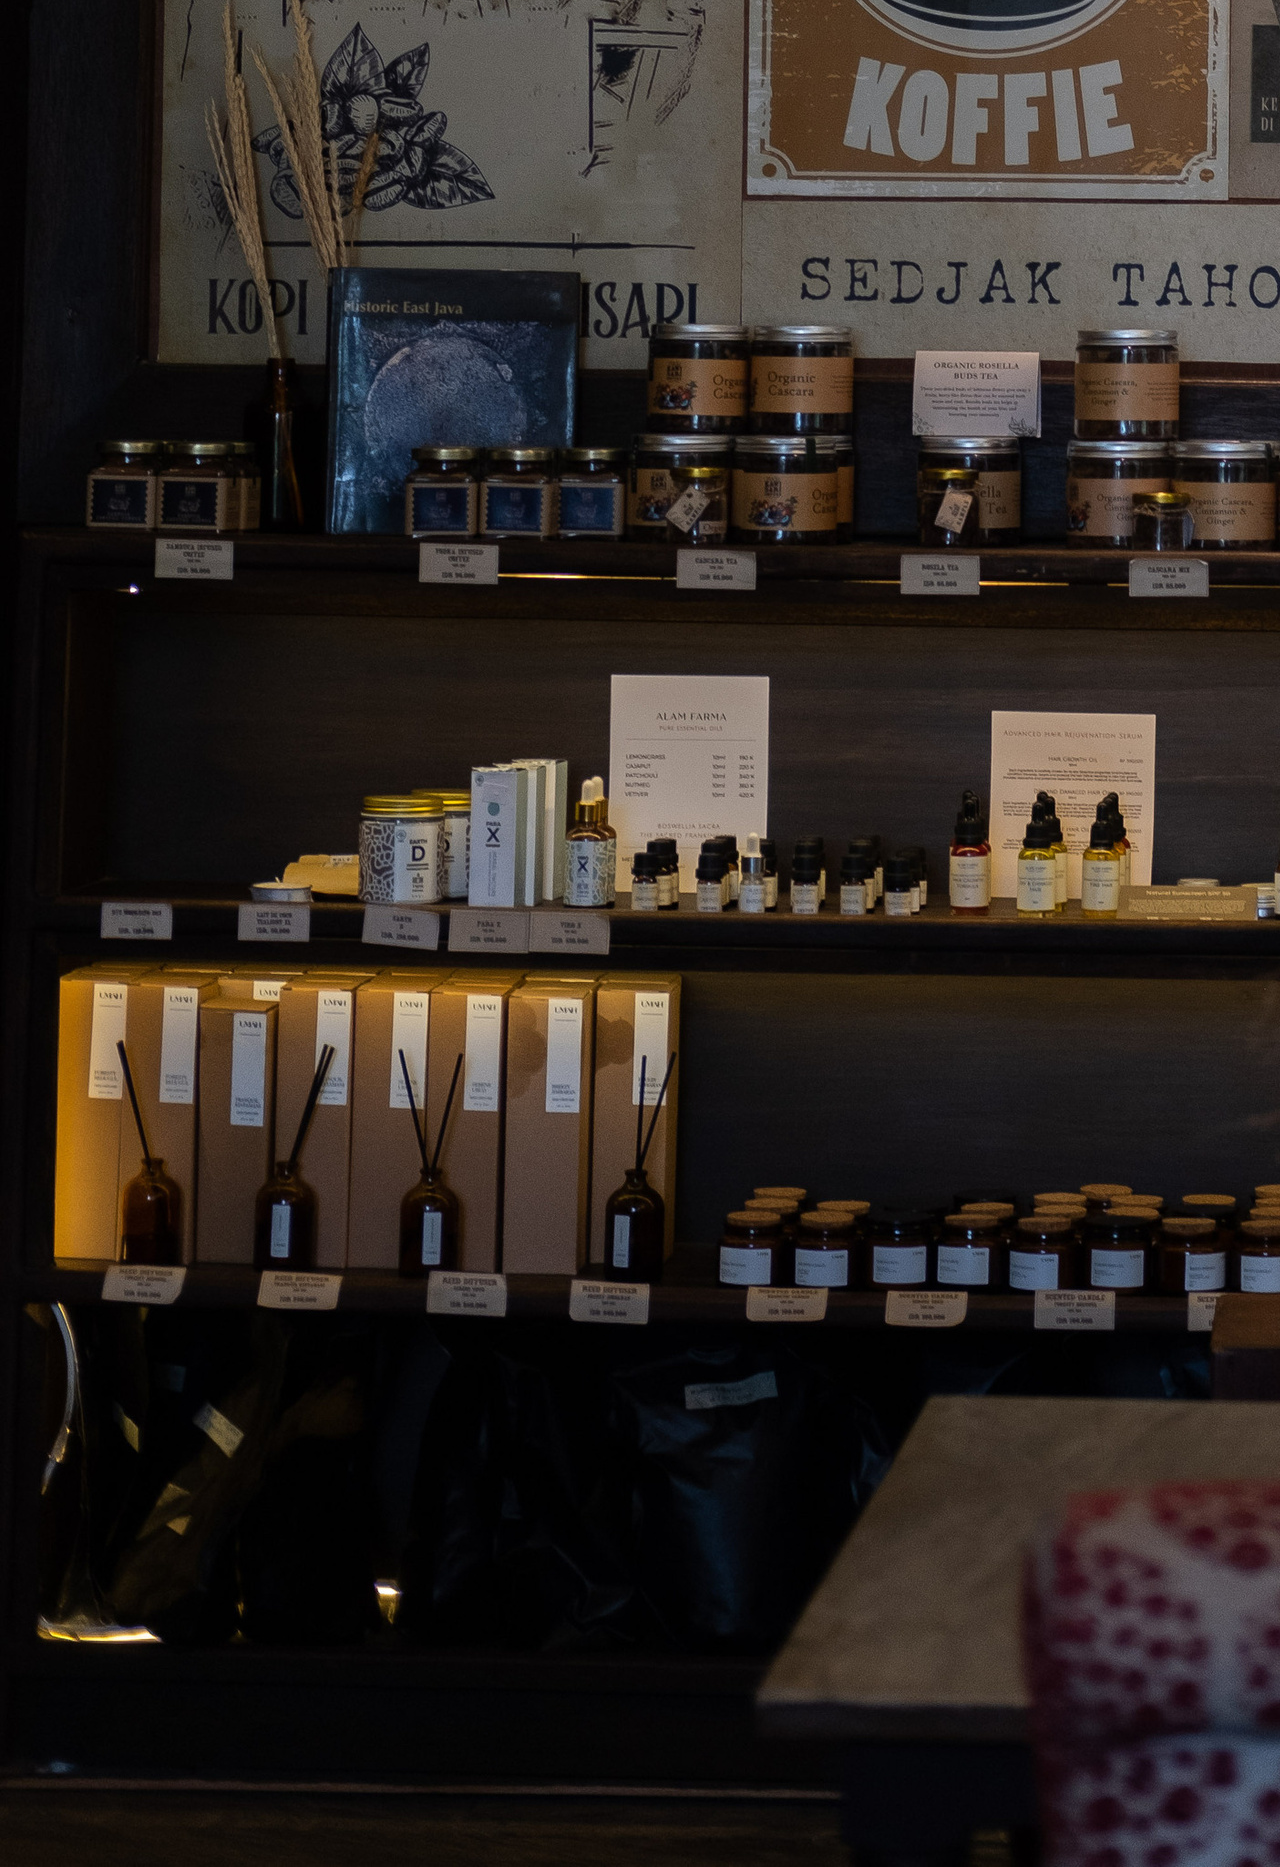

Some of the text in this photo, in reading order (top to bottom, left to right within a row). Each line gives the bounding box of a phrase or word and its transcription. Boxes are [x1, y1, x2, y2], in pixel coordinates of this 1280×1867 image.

[842, 55, 1136, 167] KOFFIE
[1260, 117, 1274, 132] DI
[800, 256, 1062, 306] SEDJAK
[207, 277, 310, 336] KOPI
[343, 298, 464, 316] Historic East Java
[933, 361, 1020, 370] ORGANIC ROSELLA
[767, 370, 816, 385] Organic
[953, 372, 999, 380] BUDS TEA
[768, 384, 815, 397] Cascara
[976, 485, 1001, 498] ella
[986, 502, 1008, 514] Tea
[656, 712, 727, 722] ALAM FARMA
[487, 827, 500, 843] X
[412, 845, 425, 862] D
